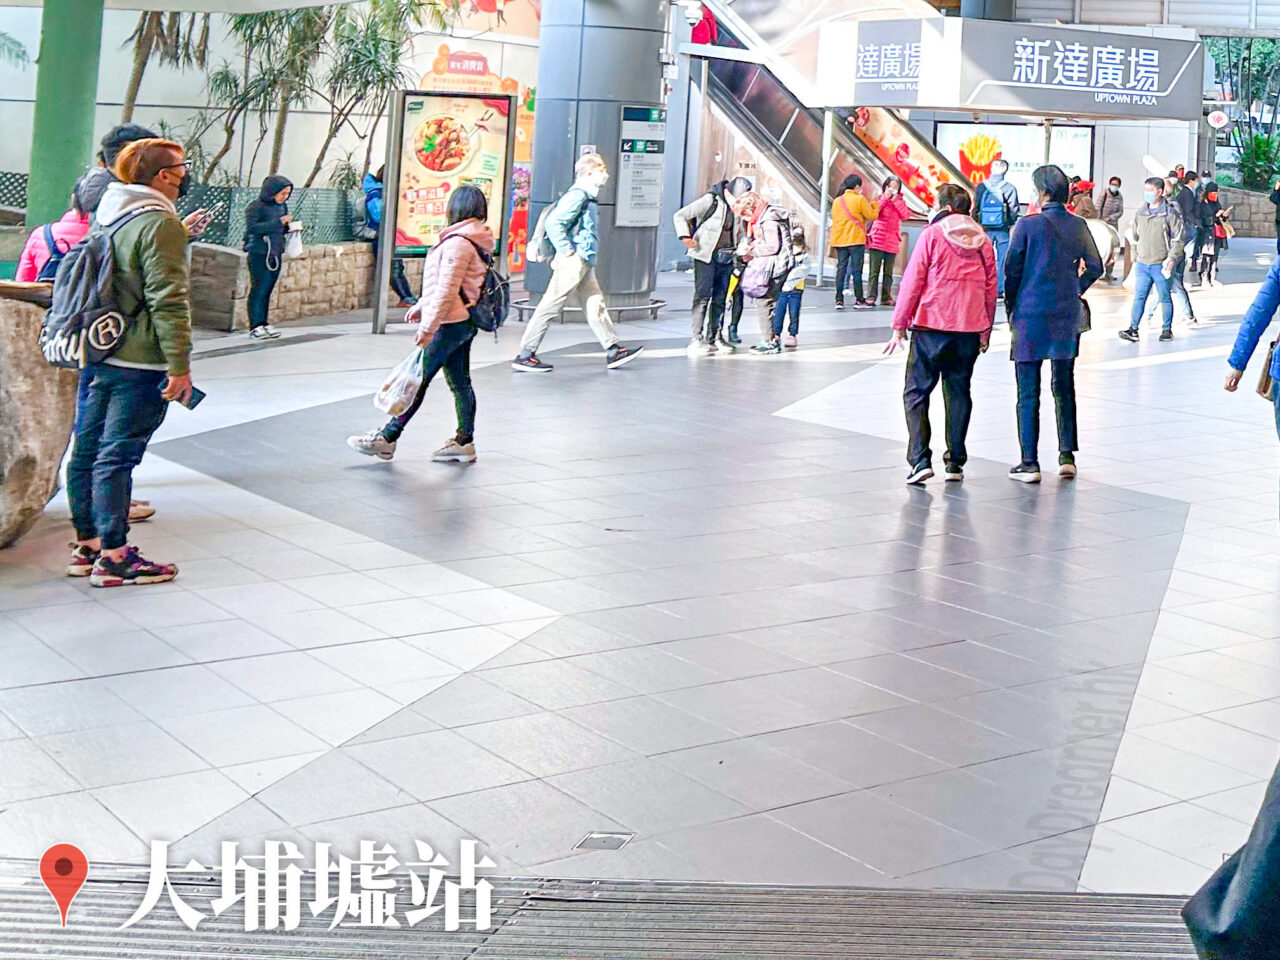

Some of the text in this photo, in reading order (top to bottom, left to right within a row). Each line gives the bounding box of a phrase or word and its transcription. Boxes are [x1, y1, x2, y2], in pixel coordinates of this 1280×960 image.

[1012, 37, 1160, 93] 新達廣場
[1095, 92, 1158, 106] UPTOWN PLAZA
